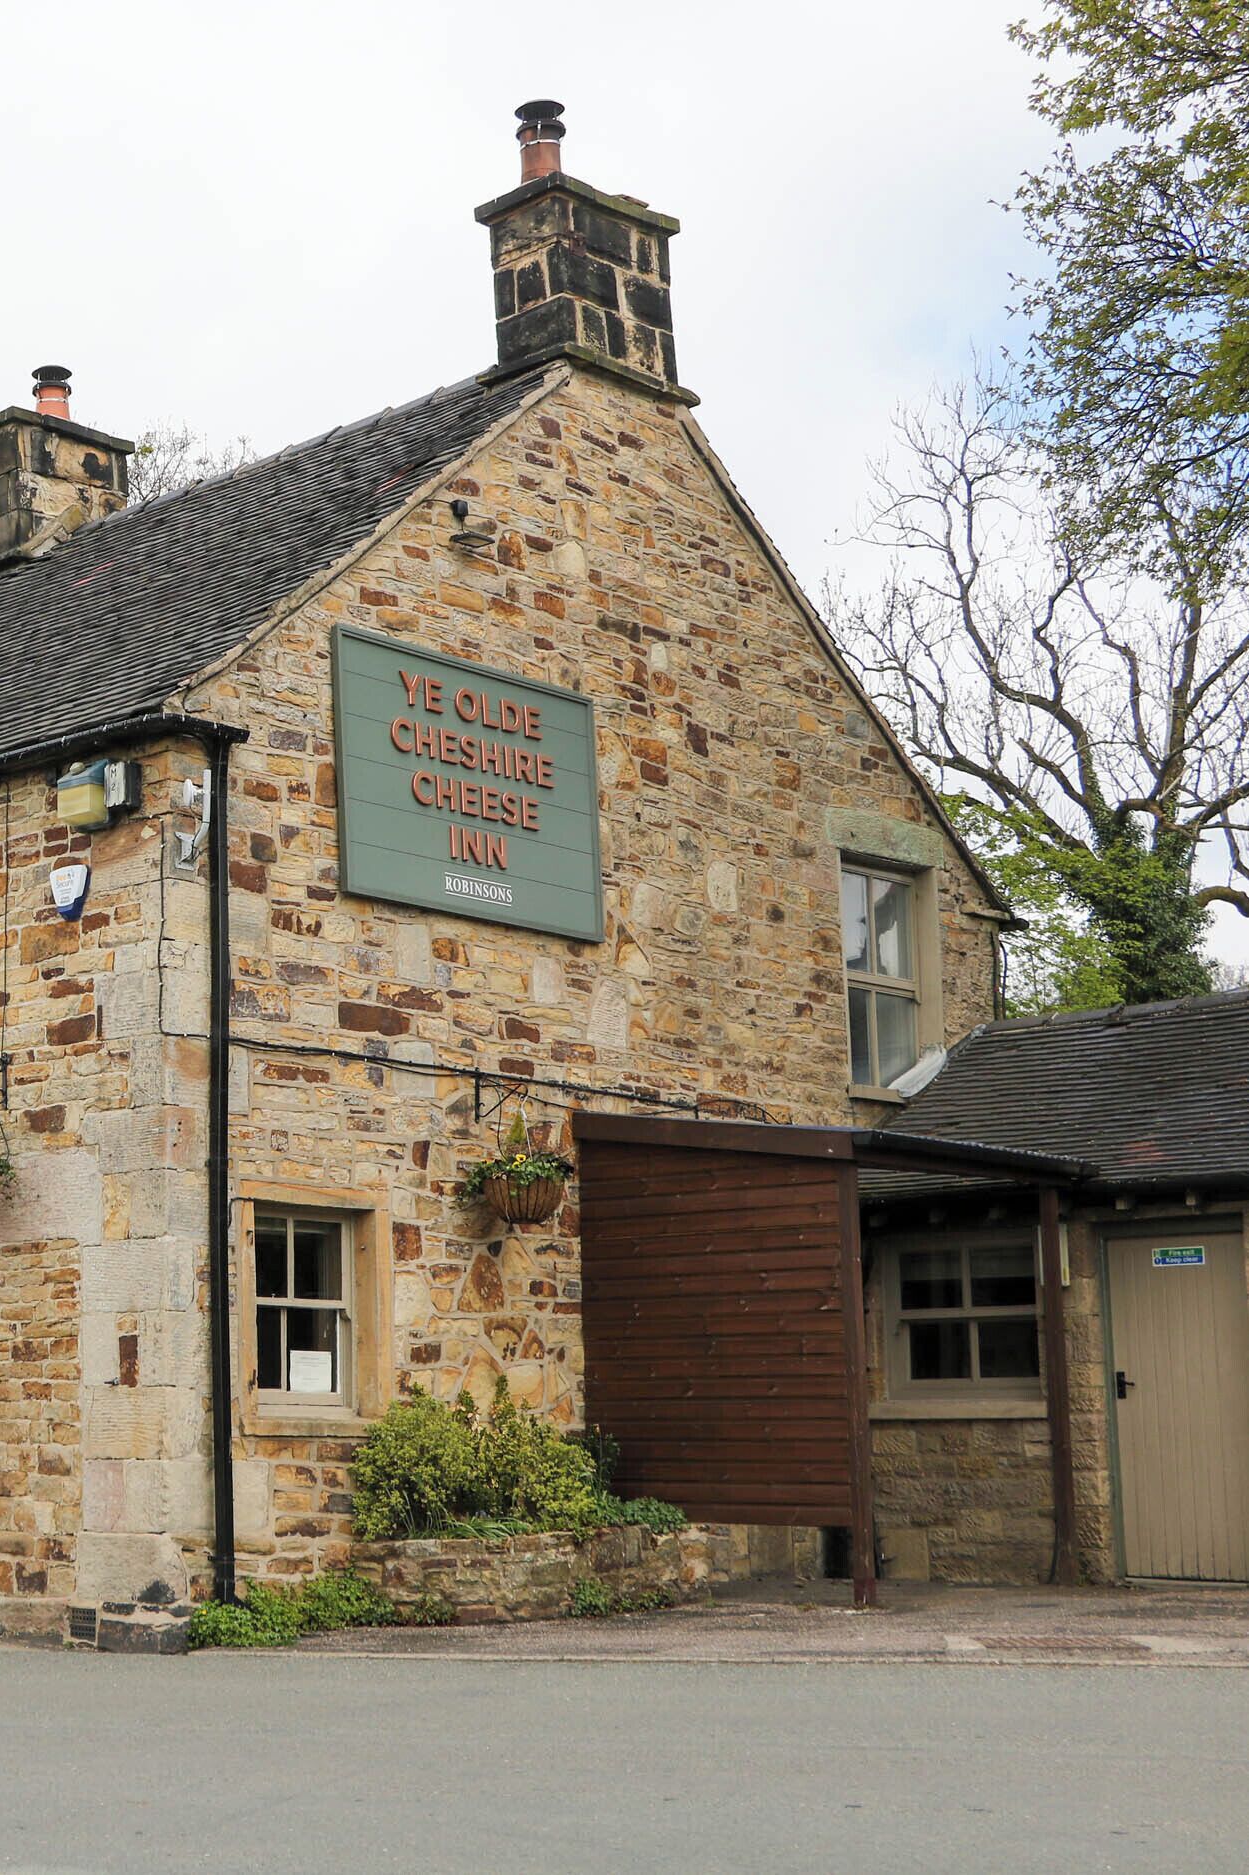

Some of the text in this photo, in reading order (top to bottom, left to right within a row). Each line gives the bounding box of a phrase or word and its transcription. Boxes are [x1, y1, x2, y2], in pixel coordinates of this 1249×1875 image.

[399, 670, 543, 741] YE OLDE
[390, 716, 555, 789] CHESHIRE
[411, 770, 541, 832] CHEESE
[449, 824, 508, 870] INN
[444, 875, 513, 903] ROBINSONS
